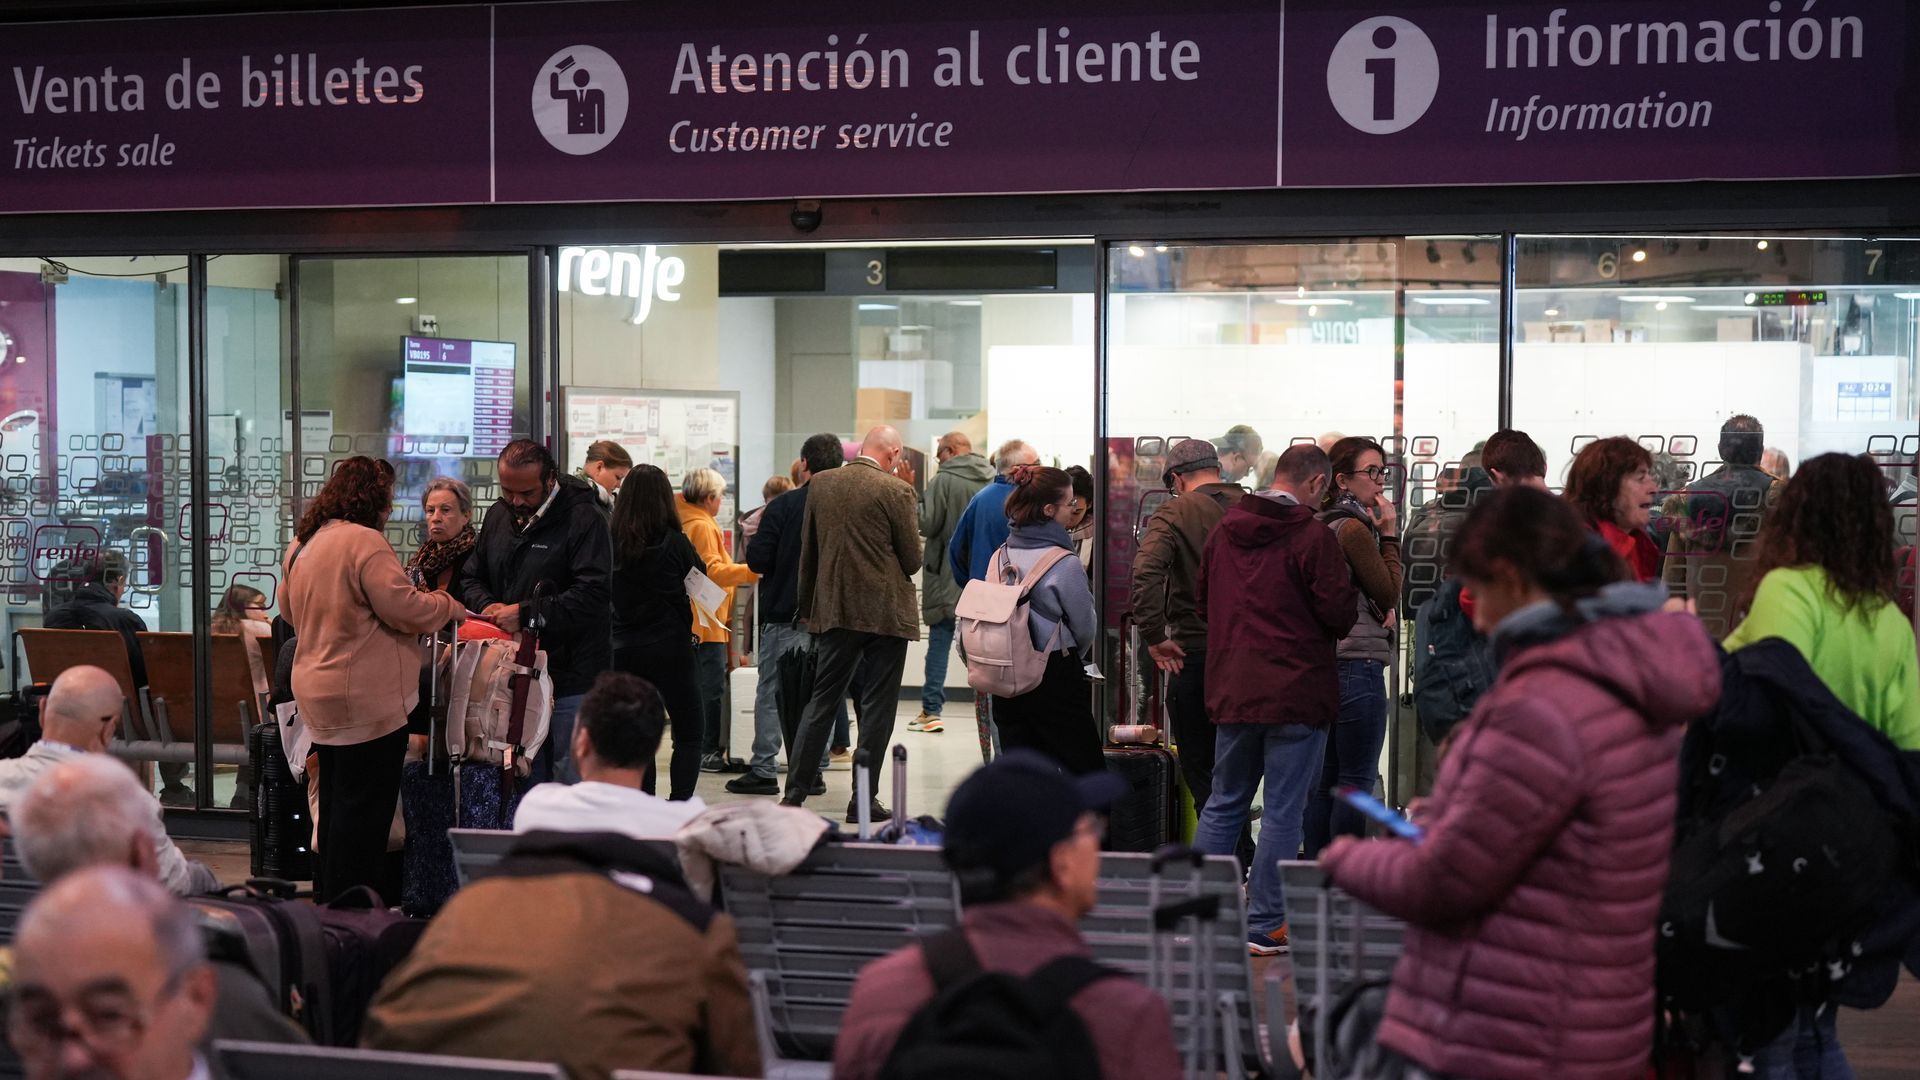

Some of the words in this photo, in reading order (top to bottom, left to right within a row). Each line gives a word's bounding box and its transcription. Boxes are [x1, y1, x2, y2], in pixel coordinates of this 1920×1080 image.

[1485, 0, 1865, 69] Información
[669, 33, 909, 95] Atención
[933, 29, 985, 87] al
[1006, 26, 1200, 84] cliente
[13, 66, 146, 114] Venta
[164, 58, 221, 110] de
[242, 53, 425, 107] billetes
[669, 119, 825, 153] Customer
[836, 112, 953, 150] service
[1485, 90, 1713, 141] Information
[13, 136, 106, 169] Tickets
[117, 133, 176, 166] sale
[866, 259, 884, 286] 3
[1597, 252, 1618, 279] 6
[1865, 249, 1883, 276] 7
[558, 246, 686, 325] renfe
[1862, 382, 1886, 392] 2024
[36, 540, 96, 566] renfe
